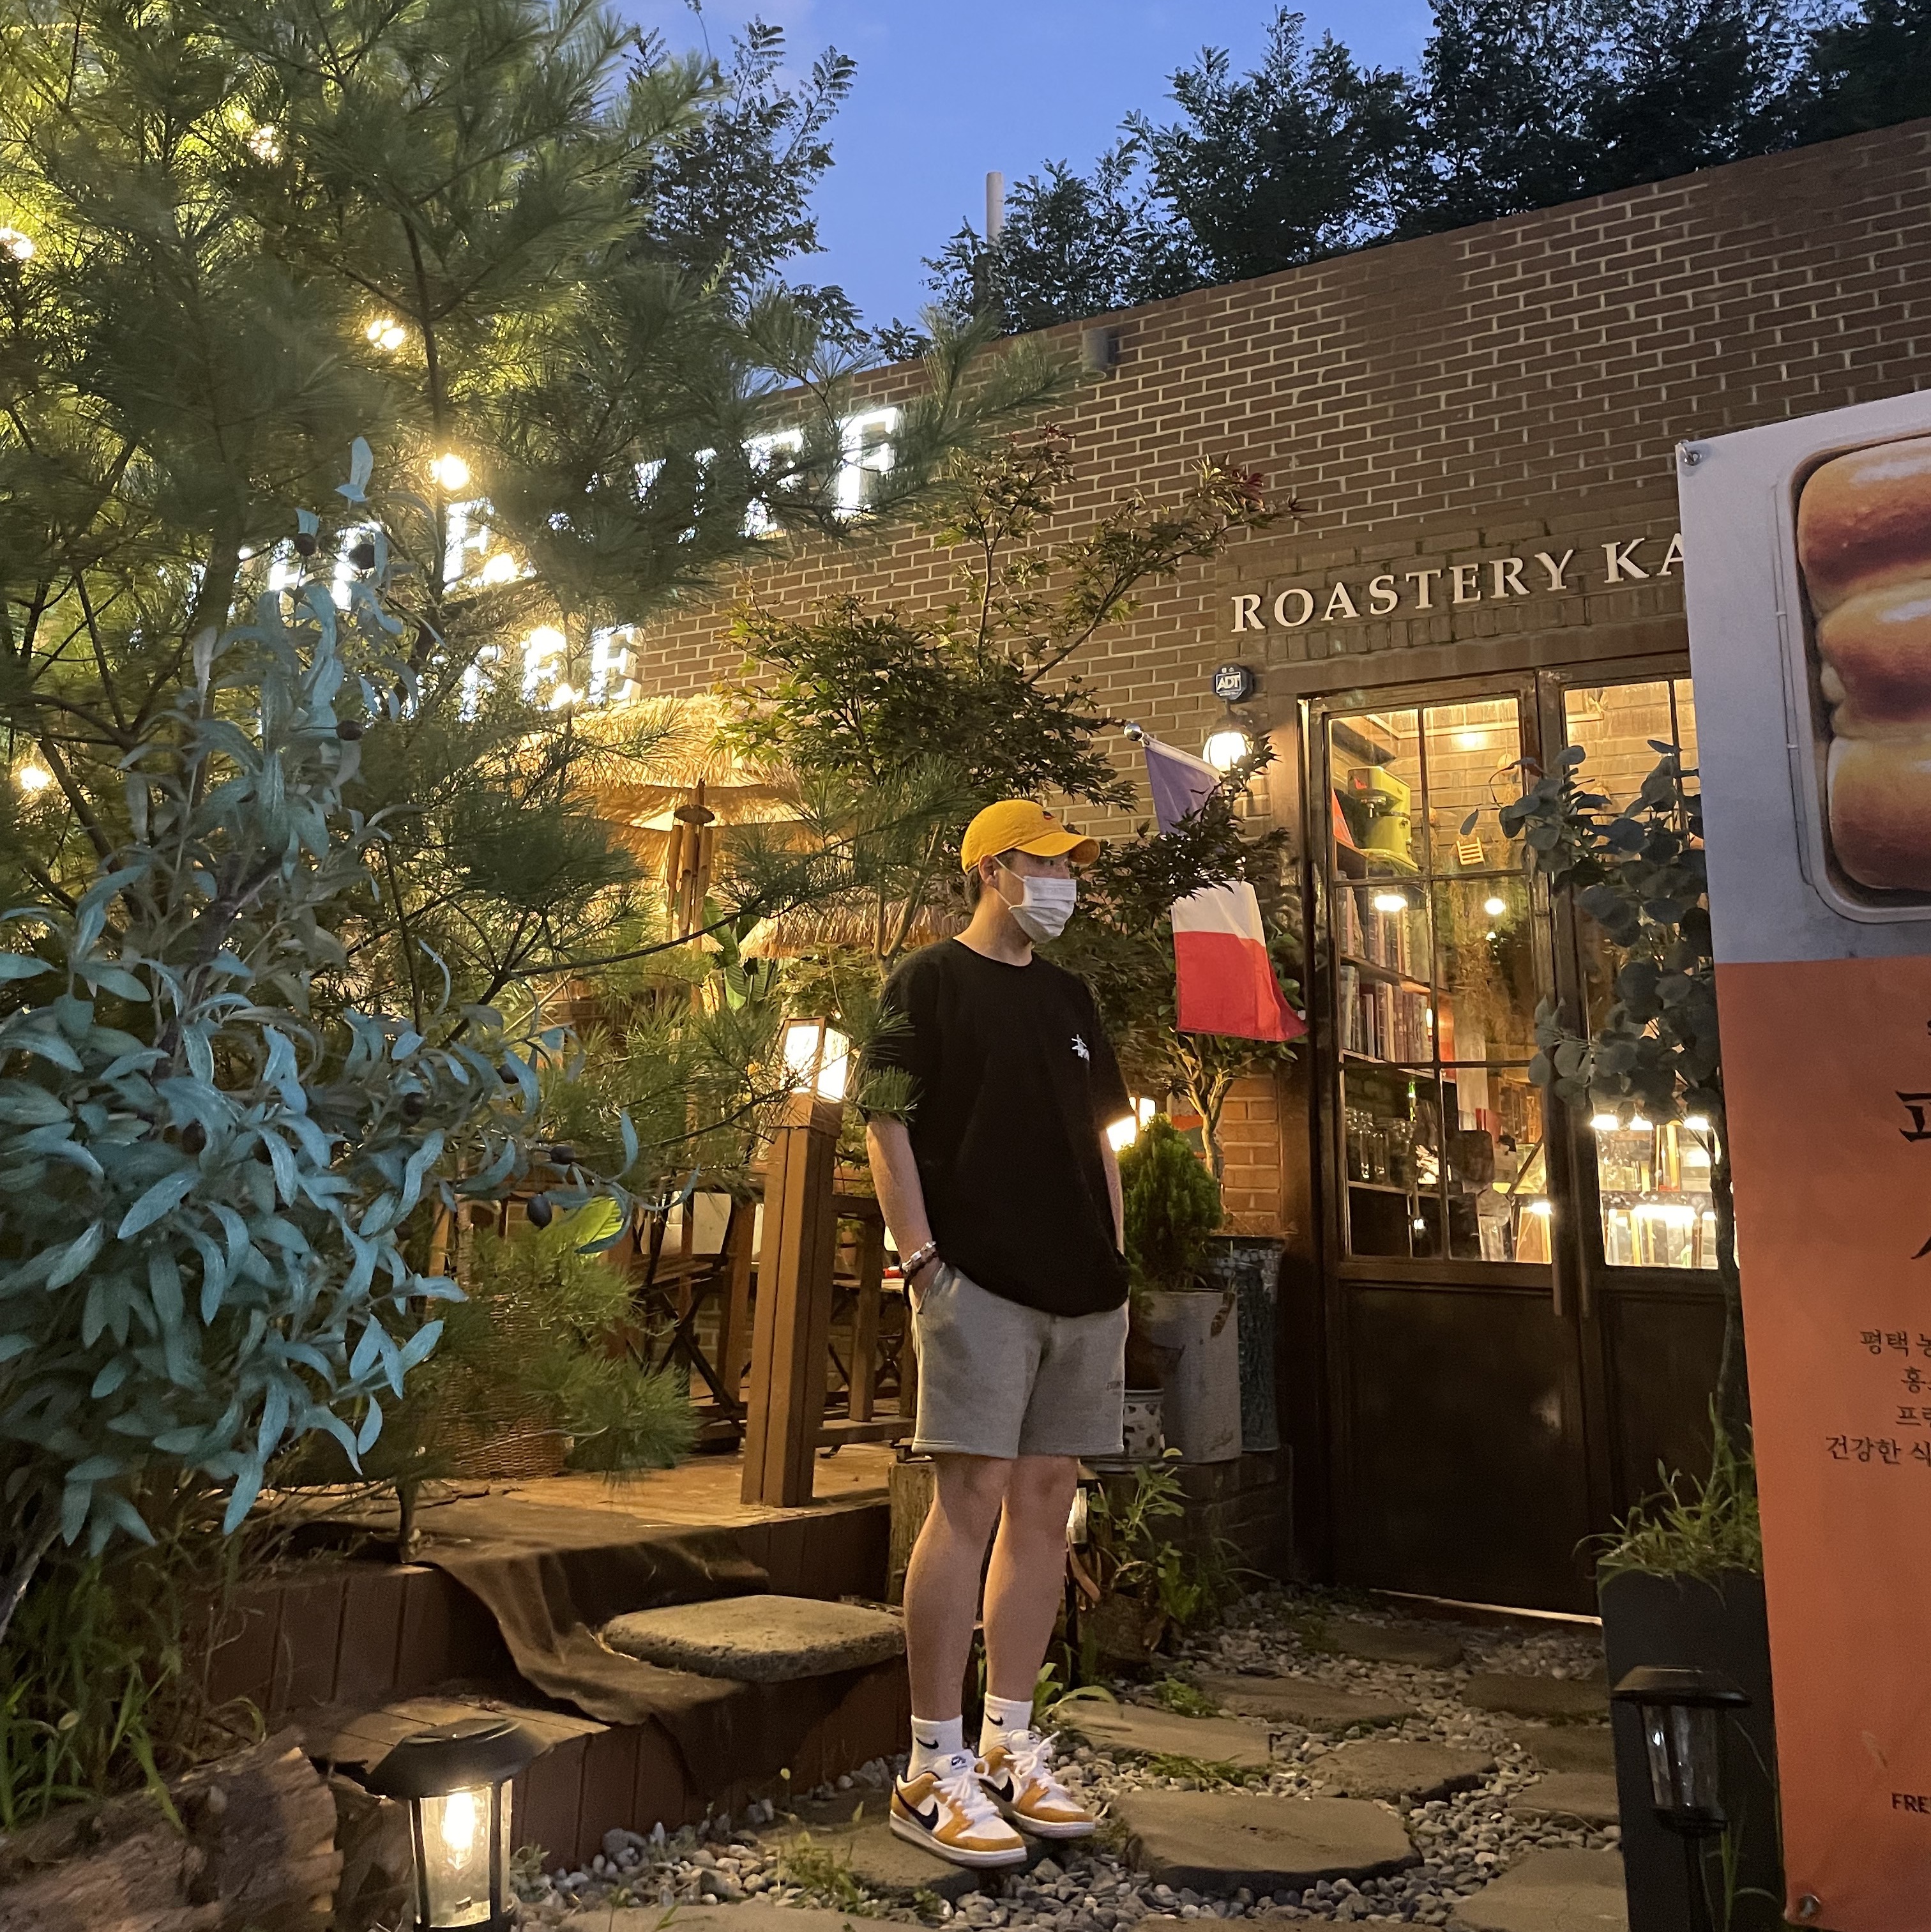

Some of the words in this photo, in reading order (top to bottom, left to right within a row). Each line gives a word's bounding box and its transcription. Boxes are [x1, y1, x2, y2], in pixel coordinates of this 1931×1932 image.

[1231, 549, 1575, 632] ROASTERY
[1216, 674, 1241, 690] ADT
[1859, 1328, 1909, 1357] 평택
[1901, 1365, 1931, 1394] 홍
[1825, 1435, 1902, 1464] 건강한
[1891, 1792, 1931, 1814] FRE
